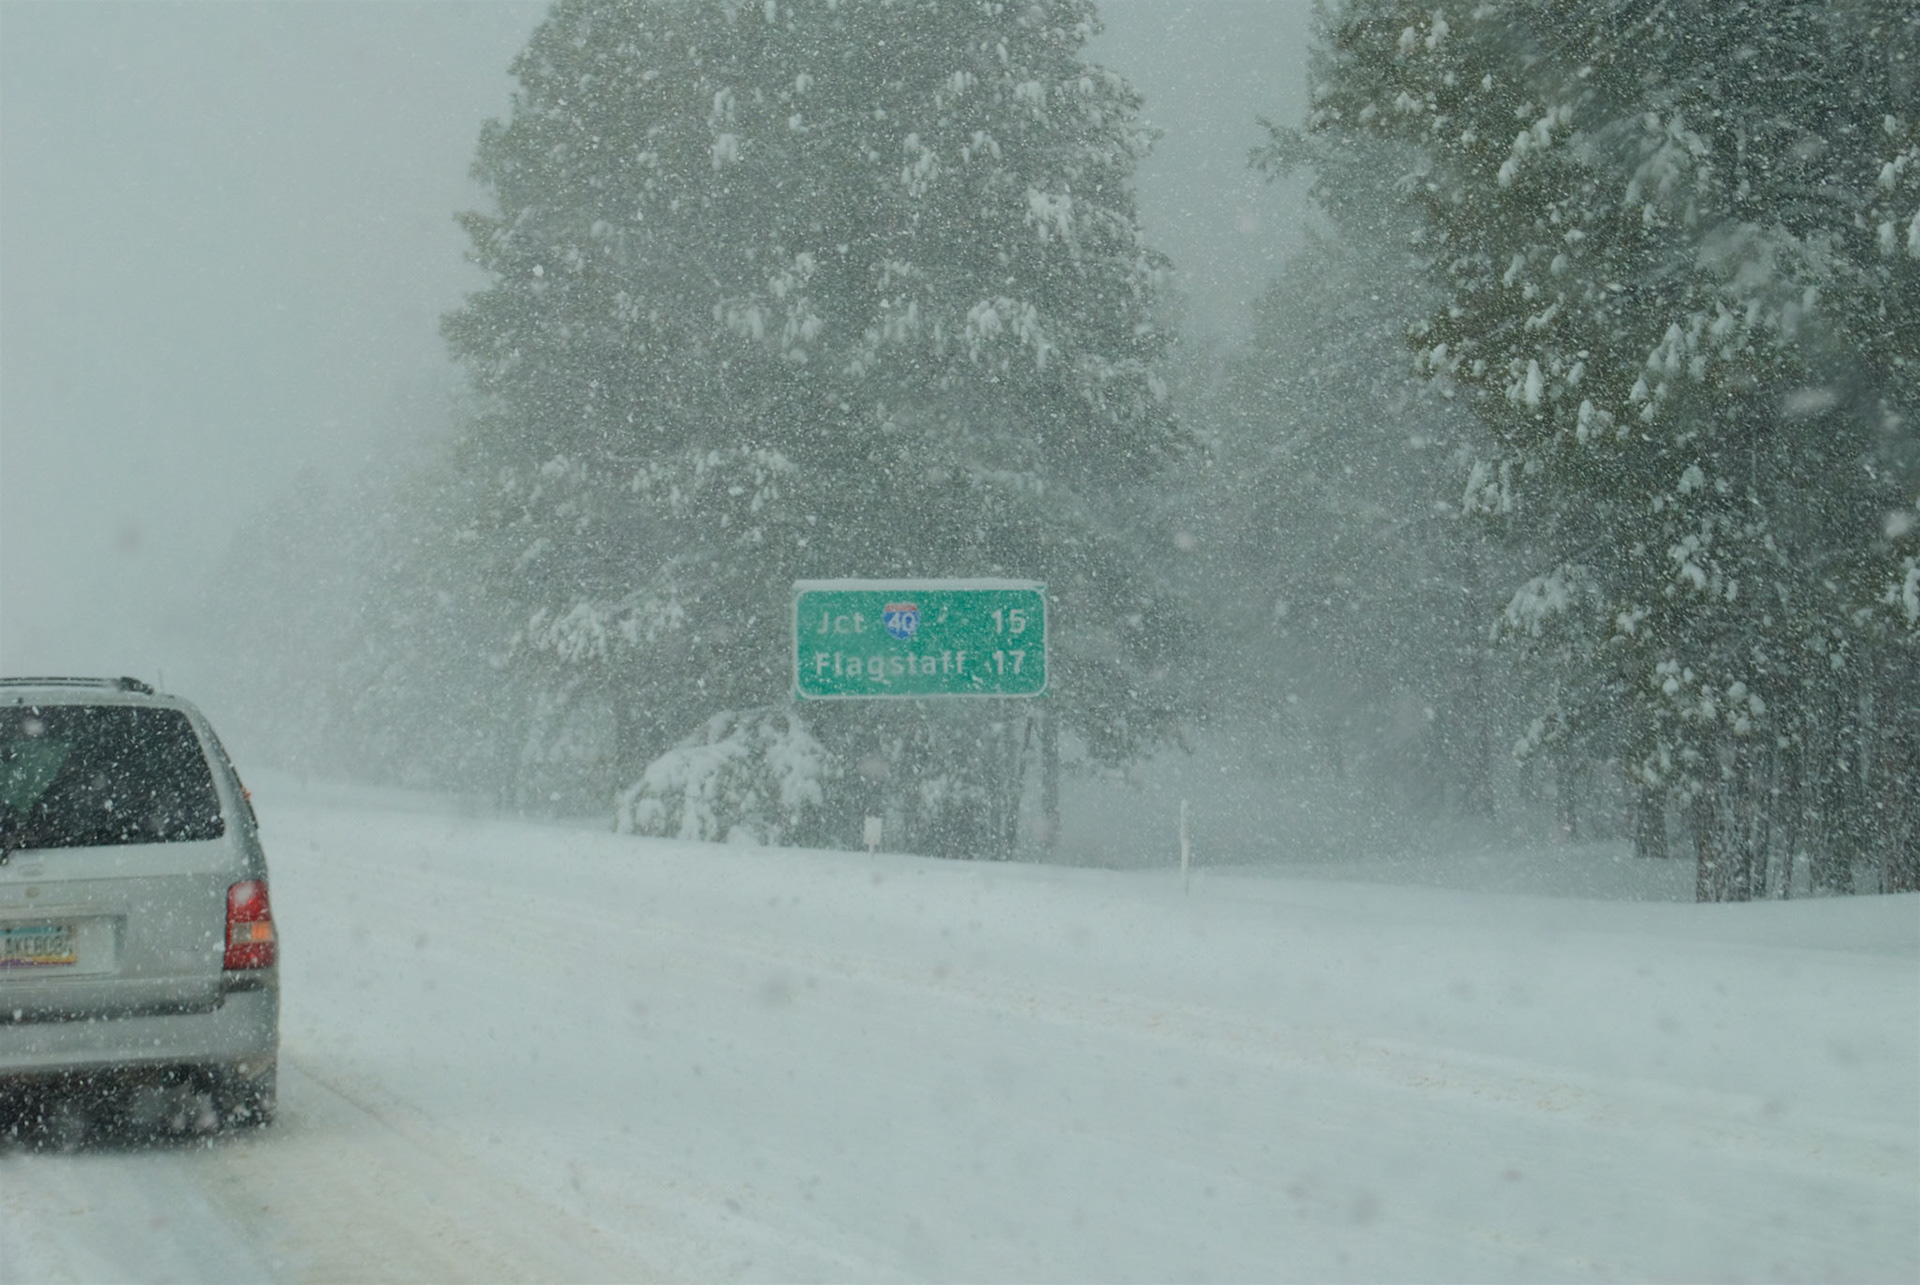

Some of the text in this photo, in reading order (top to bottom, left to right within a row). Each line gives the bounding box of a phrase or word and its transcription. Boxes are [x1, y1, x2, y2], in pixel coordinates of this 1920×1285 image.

[817, 608, 1027, 634] Jct 40 15
[815, 649, 1026, 682] Flagstaff 17
